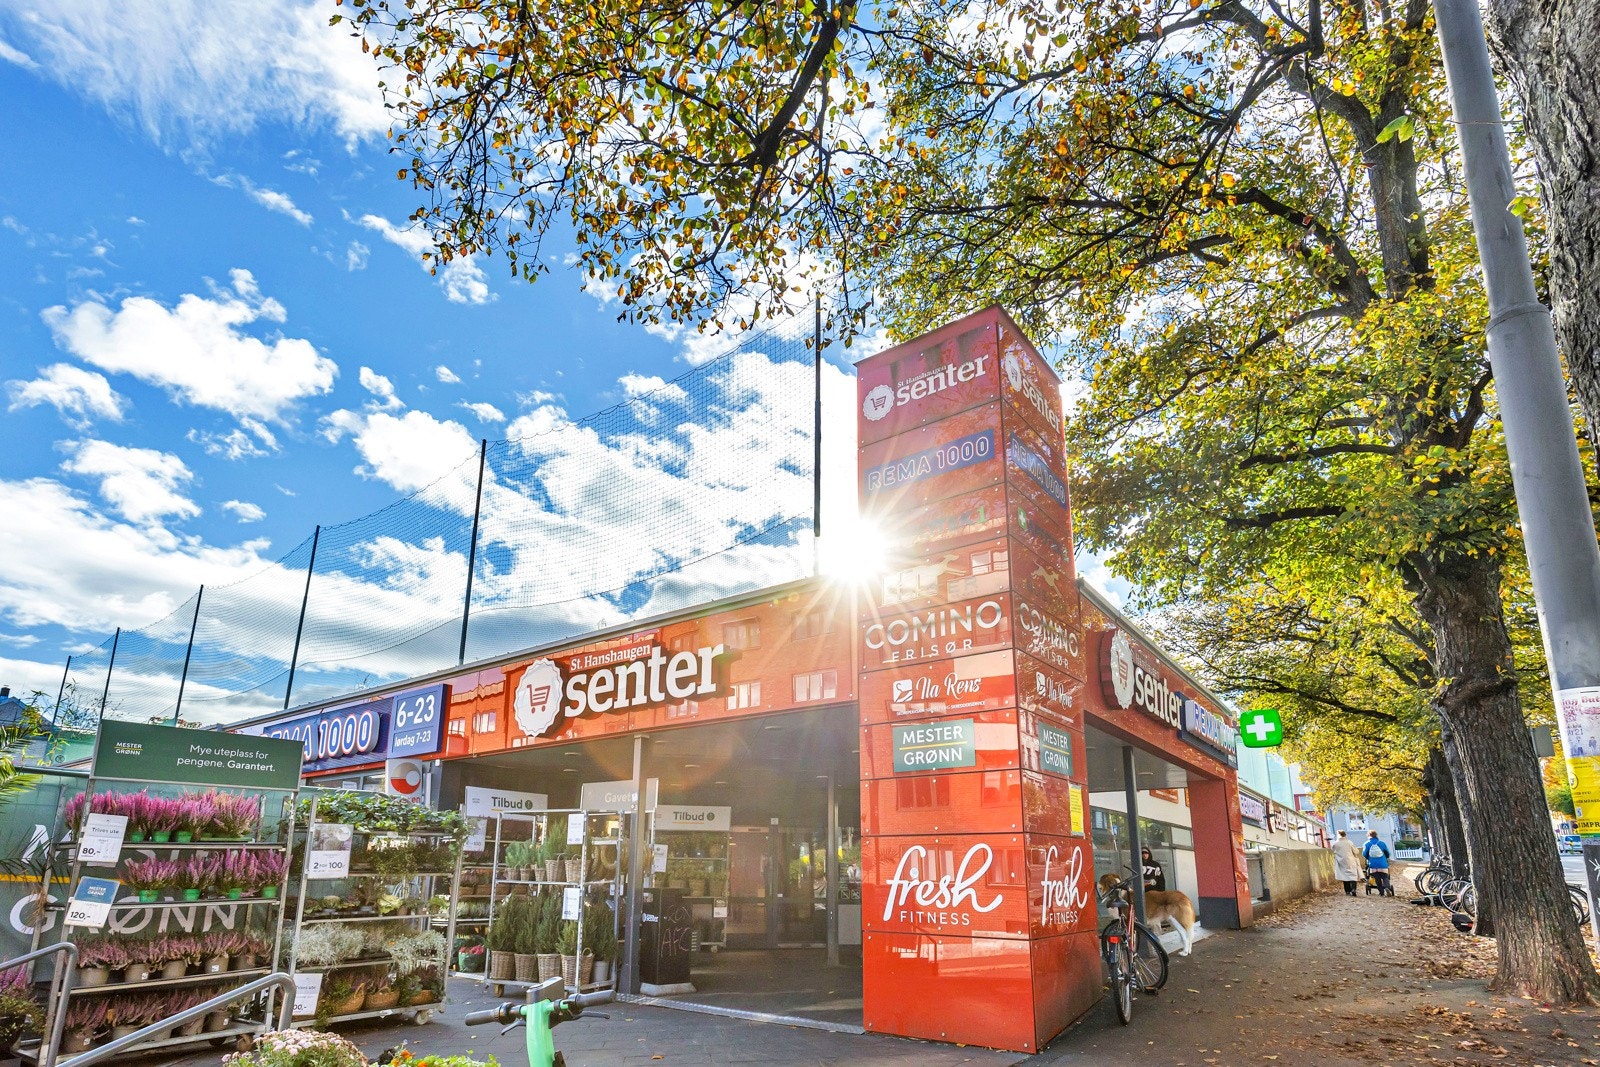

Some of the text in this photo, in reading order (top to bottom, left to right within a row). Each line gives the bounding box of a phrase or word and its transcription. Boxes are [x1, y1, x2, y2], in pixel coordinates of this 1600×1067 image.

[896, 354, 989, 407] senter
[1022, 379, 1061, 434] senter
[868, 436, 989, 491] REMA 1000
[1012, 438, 1066, 504] REMA 1000
[865, 600, 1002, 649] COMINO
[1020, 603, 1079, 657] COMINO
[570, 644, 652, 671] St. Hanshaugen
[892, 639, 973, 662] FRISØR
[564, 643, 725, 718] senter
[915, 672, 982, 700] Ila Rens
[396, 694, 435, 728] 6-23
[1135, 667, 1182, 731] senter
[318, 709, 374, 761] 1000
[902, 725, 964, 745] MESTER
[1193, 701, 1219, 743] REMA
[190, 744, 269, 760] Mye uteplass for
[394, 730, 432, 748] lørdag 7-23
[1043, 729, 1069, 750] MESTER
[176, 757, 276, 772] pengene. Garantert.
[903, 747, 963, 766] GRØNN
[1044, 750, 1069, 770] GRØNN
[491, 796, 523, 809] Tilbud
[604, 792, 631, 803] Gavet
[673, 811, 704, 821] Tilbud
[883, 843, 1003, 921] fresh
[1041, 845, 1088, 927] fresh
[900, 911, 970, 926] FITNESS
[1049, 911, 1079, 925] FITNESS
